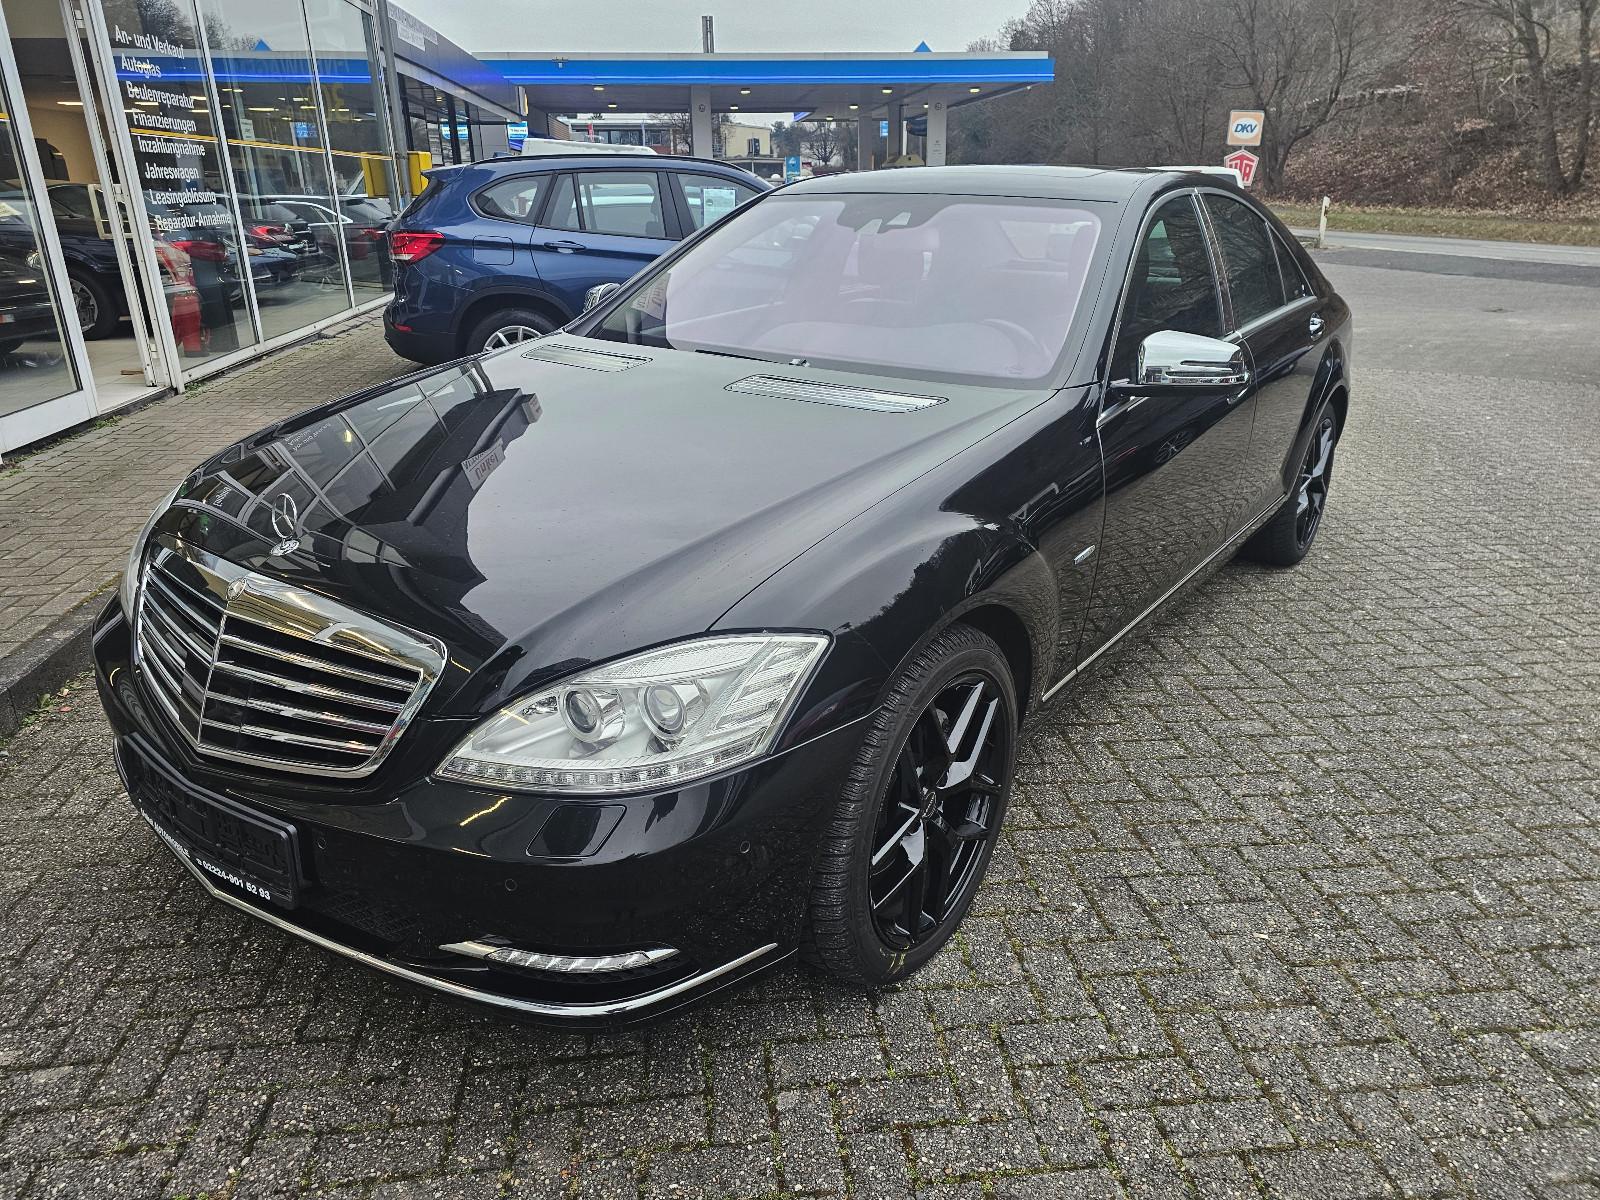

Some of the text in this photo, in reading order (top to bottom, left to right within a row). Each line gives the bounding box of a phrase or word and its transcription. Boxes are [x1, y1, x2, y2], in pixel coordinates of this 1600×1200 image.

[115, 24, 185, 60] An- und Verkauf
[121, 52, 162, 79] Autoglas
[126, 80, 195, 109] Beulenreparatur
[131, 107, 197, 134] Finanzierungen
[1234, 123, 1257, 134] DKV
[137, 135, 206, 158] Inzahlungnahme
[144, 162, 200, 183] Jahreswagen
[149, 187, 217, 208] Leasingablösung
[154, 211, 231, 233] Reparatur-Annahme
[202, 860, 244, 889] 02224-901
[245, 881, 258, 896] 52
[258, 886, 271, 901] 93
